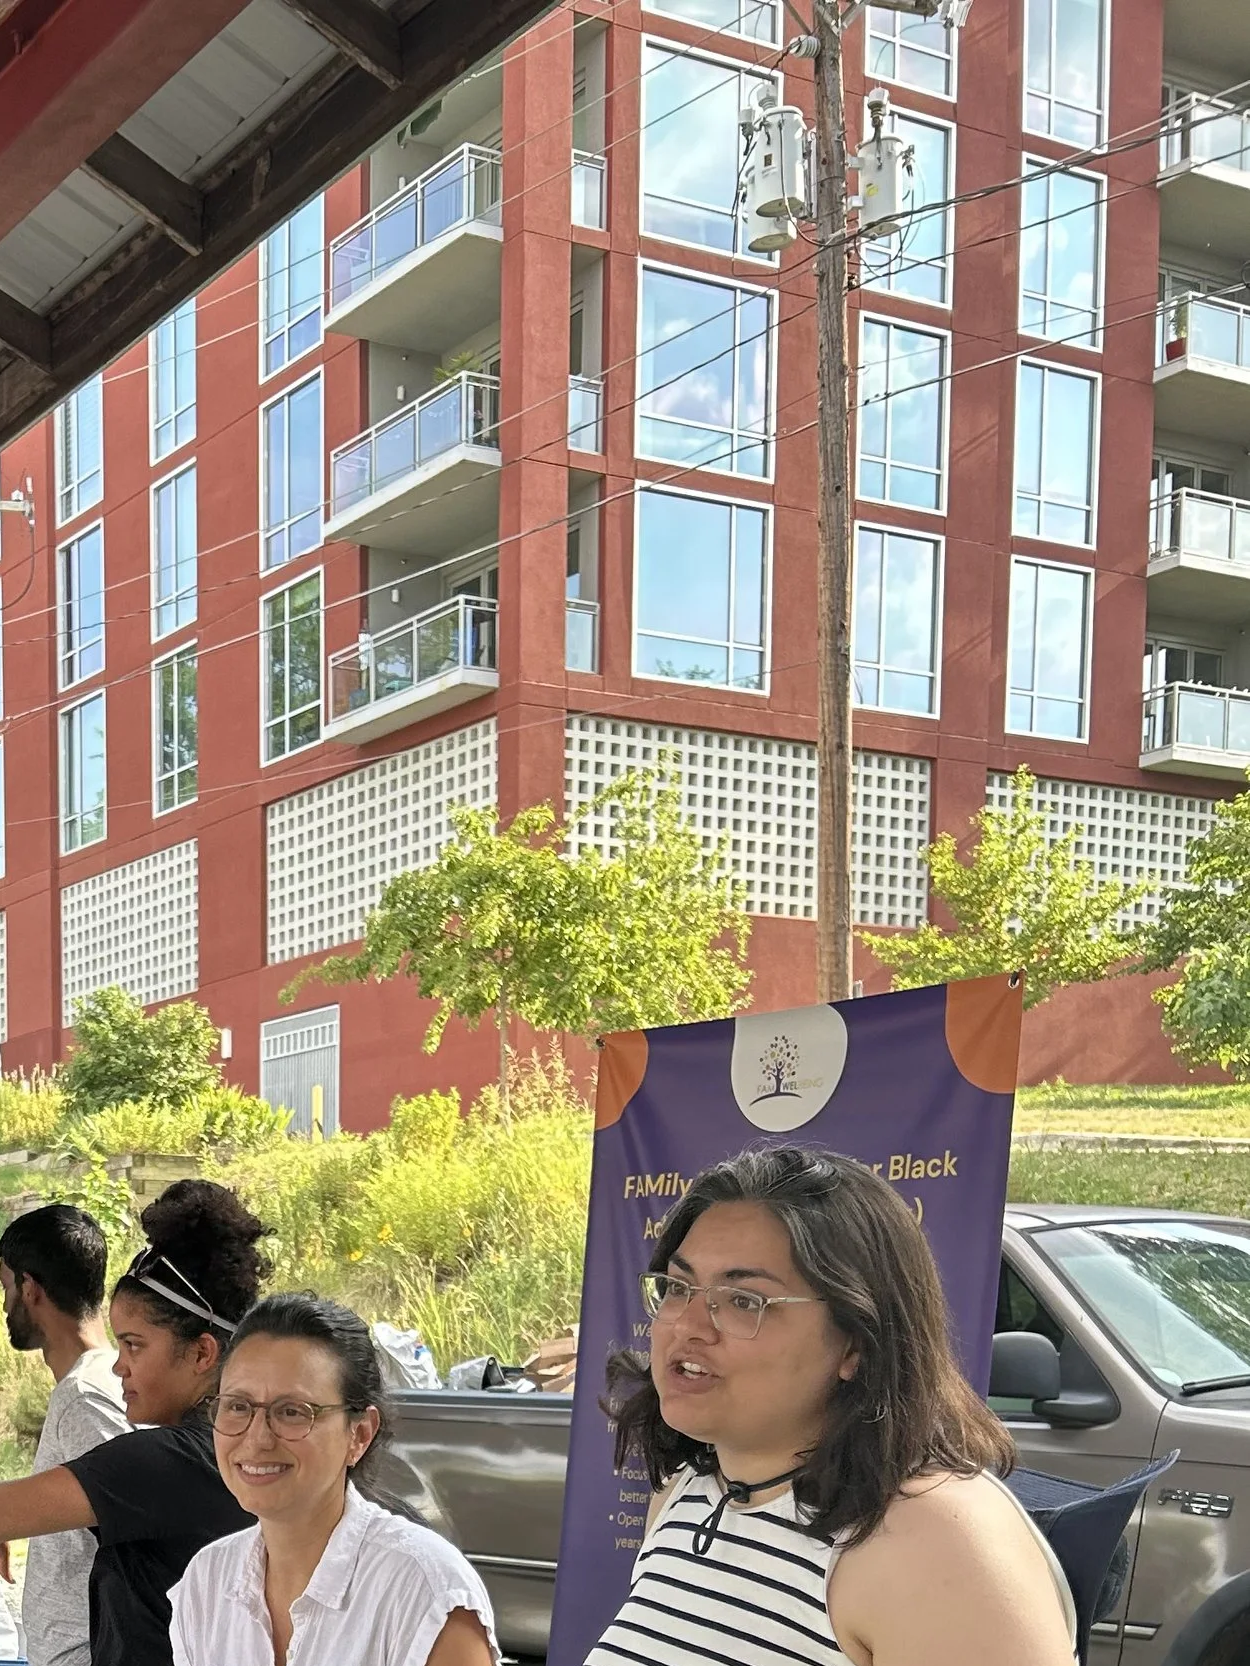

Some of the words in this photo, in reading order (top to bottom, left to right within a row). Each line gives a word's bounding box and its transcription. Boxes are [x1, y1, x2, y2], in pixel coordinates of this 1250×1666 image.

[624, 1173, 693, 1198] FAMily
[888, 1151, 958, 1180] Black
[621, 1466, 648, 1481] Focus
[619, 1489, 648, 1504] better
[617, 1511, 645, 1528] Open
[614, 1537, 642, 1550] years
